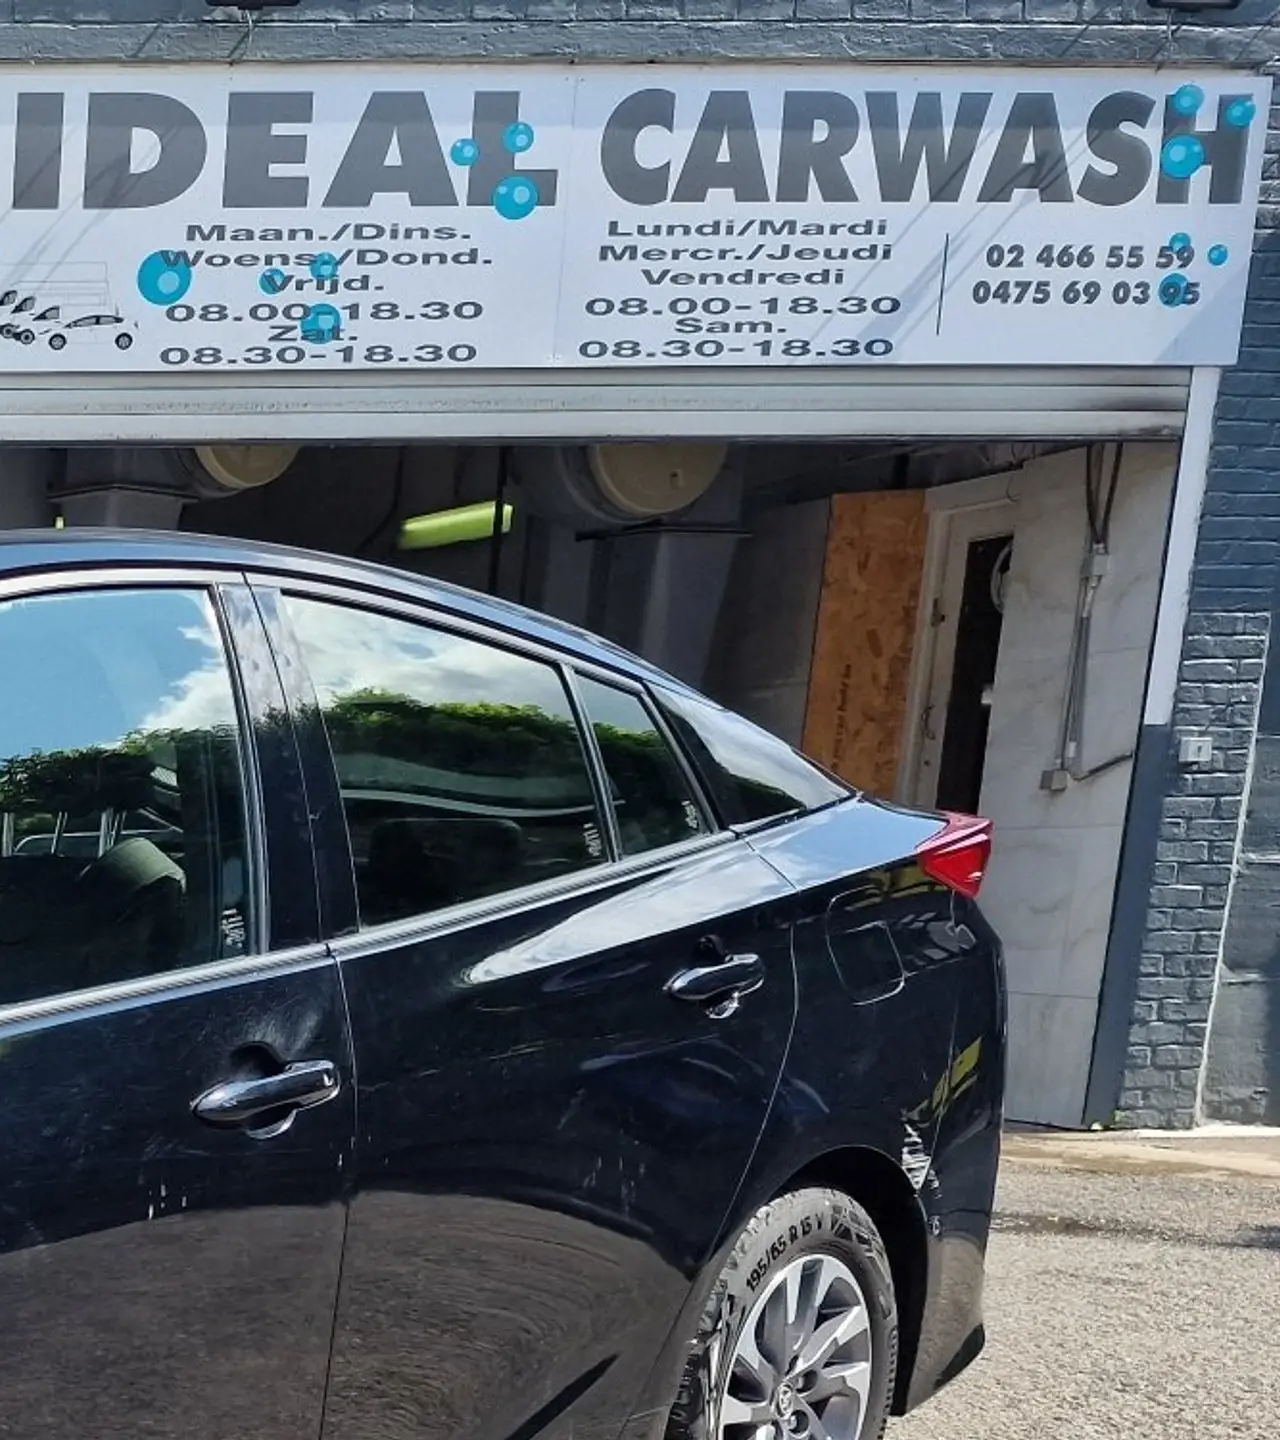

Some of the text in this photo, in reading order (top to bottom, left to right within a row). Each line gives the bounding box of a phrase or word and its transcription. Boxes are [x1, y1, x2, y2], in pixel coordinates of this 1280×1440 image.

[13, 88, 1254, 210] IDEAL CARWASH
[608, 218, 888, 236] Lundi/Mardi
[599, 244, 892, 262] Mercr./Jeudi
[986, 244, 1195, 269] 02 466 55 59
[640, 268, 844, 286] Vendredi
[972, 280, 1051, 304] 0475
[1062, 280, 1101, 304] 69
[1112, 281, 1150, 304] 03
[165, 302, 484, 322] 08.00-18.30
[585, 296, 901, 316] 08.00-18.30
[673, 317, 786, 334] Sam.
[160, 344, 478, 365] 08.30-18.30
[578, 338, 894, 358] 08.30-18.30
